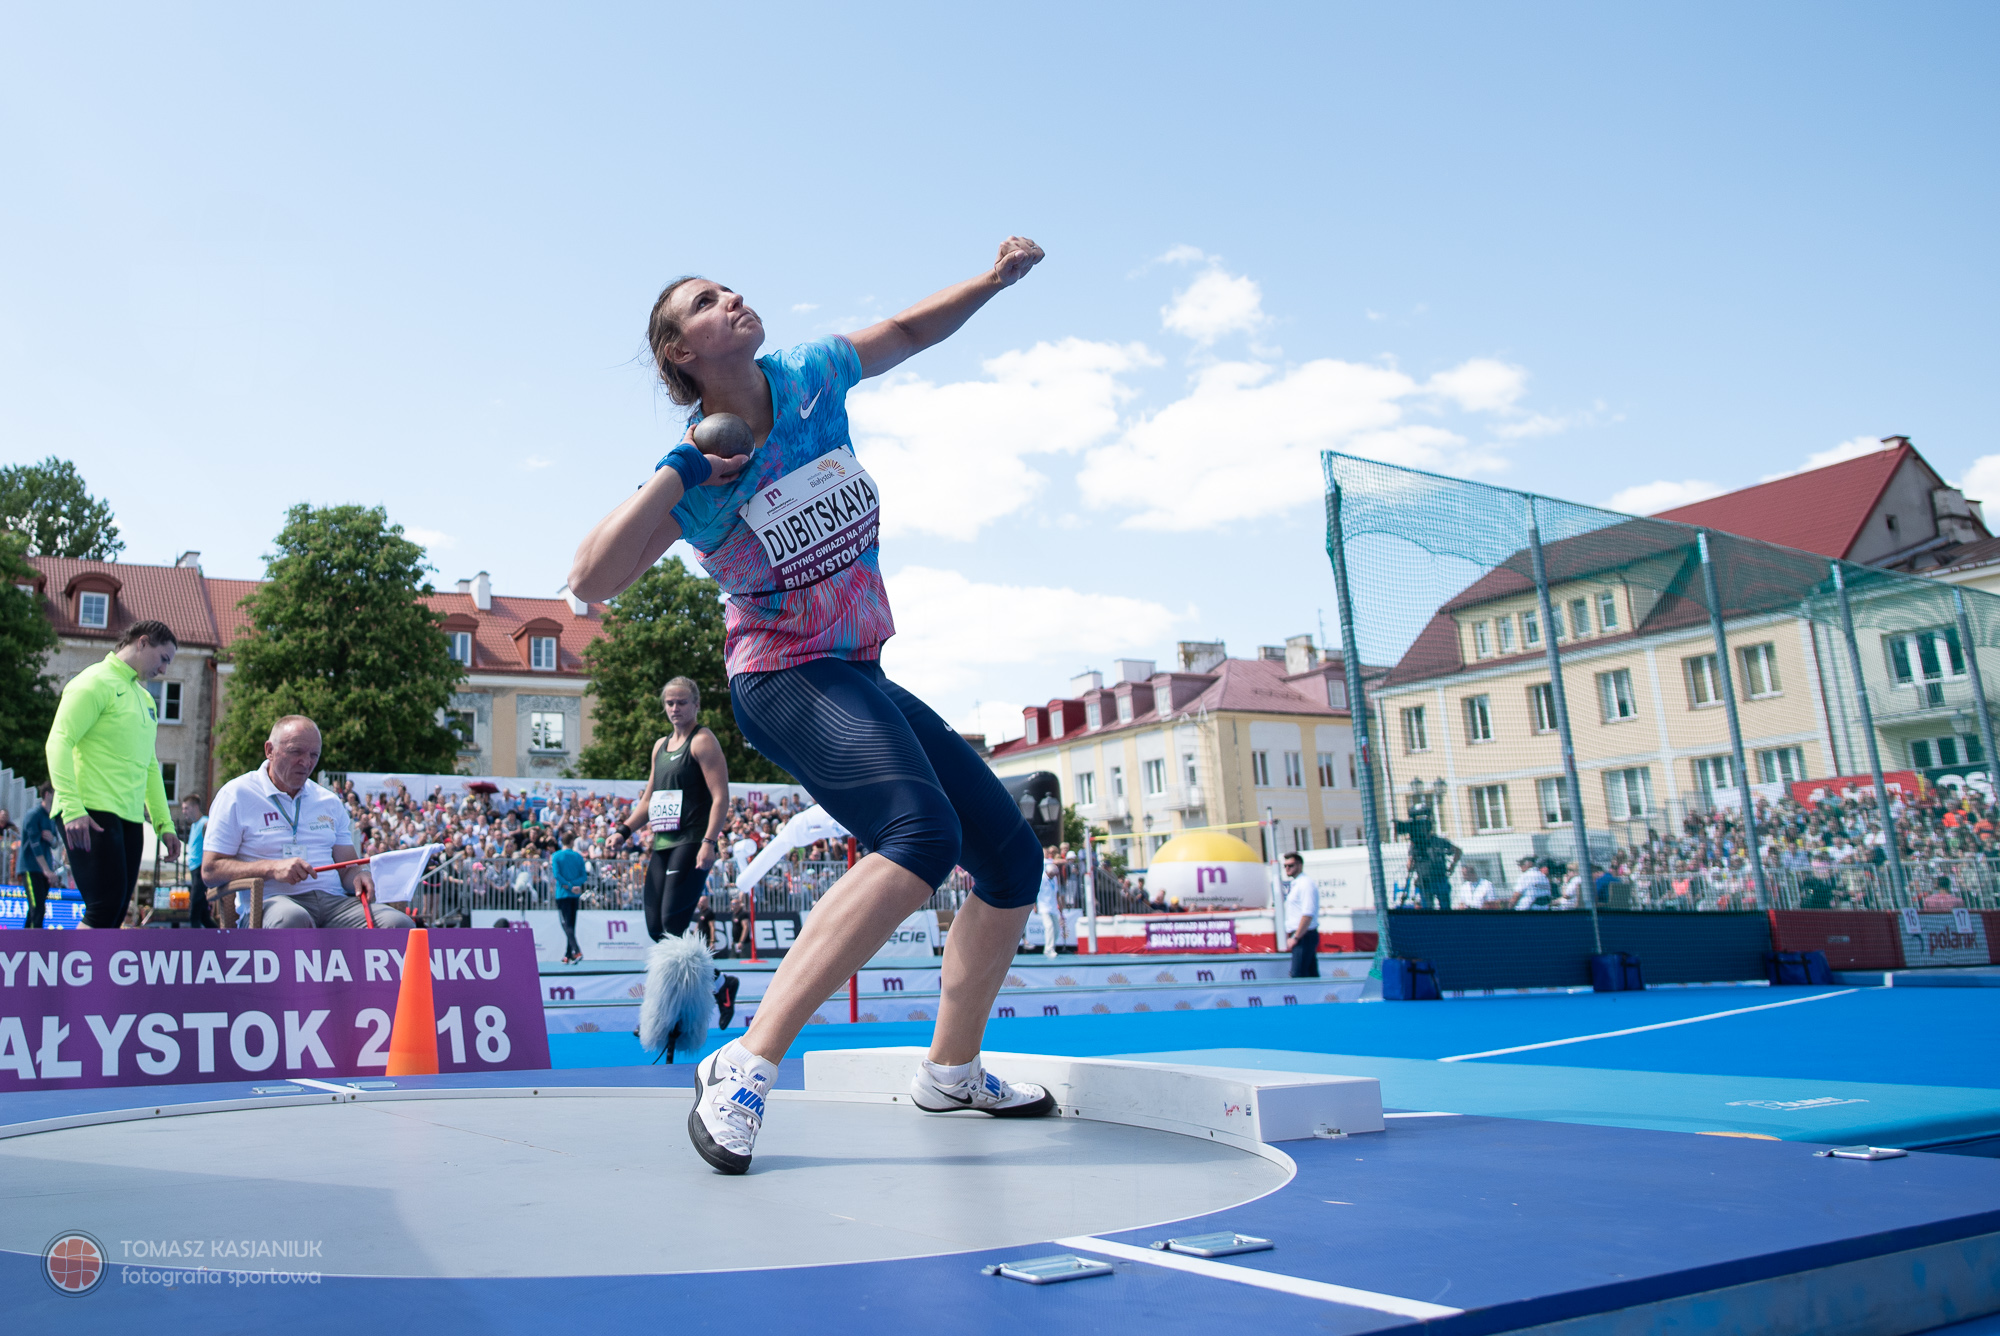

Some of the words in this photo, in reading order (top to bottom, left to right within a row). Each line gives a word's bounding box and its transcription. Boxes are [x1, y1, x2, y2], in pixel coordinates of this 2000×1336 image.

[763, 478, 878, 562] DUBITSKAYA
[781, 553, 815, 576] MITYNG
[815, 536, 846, 558] GWIAZD
[846, 529, 858, 541] NA
[858, 513, 877, 533] RYNKU
[784, 543, 859, 590] BIAŁYSTOK
[860, 525, 877, 552] 2018
[1151, 932, 1206, 948] BIAŁYSTOK
[1206, 932, 1232, 947] 2018
[1955, 909, 1967, 927] 17
[0, 950, 93, 987] YNG
[109, 949, 281, 986] GWIAZD
[294, 949, 353, 982] NA
[0, 1010, 335, 1080] AŁYSTOK
[355, 1005, 511, 1067] 218
